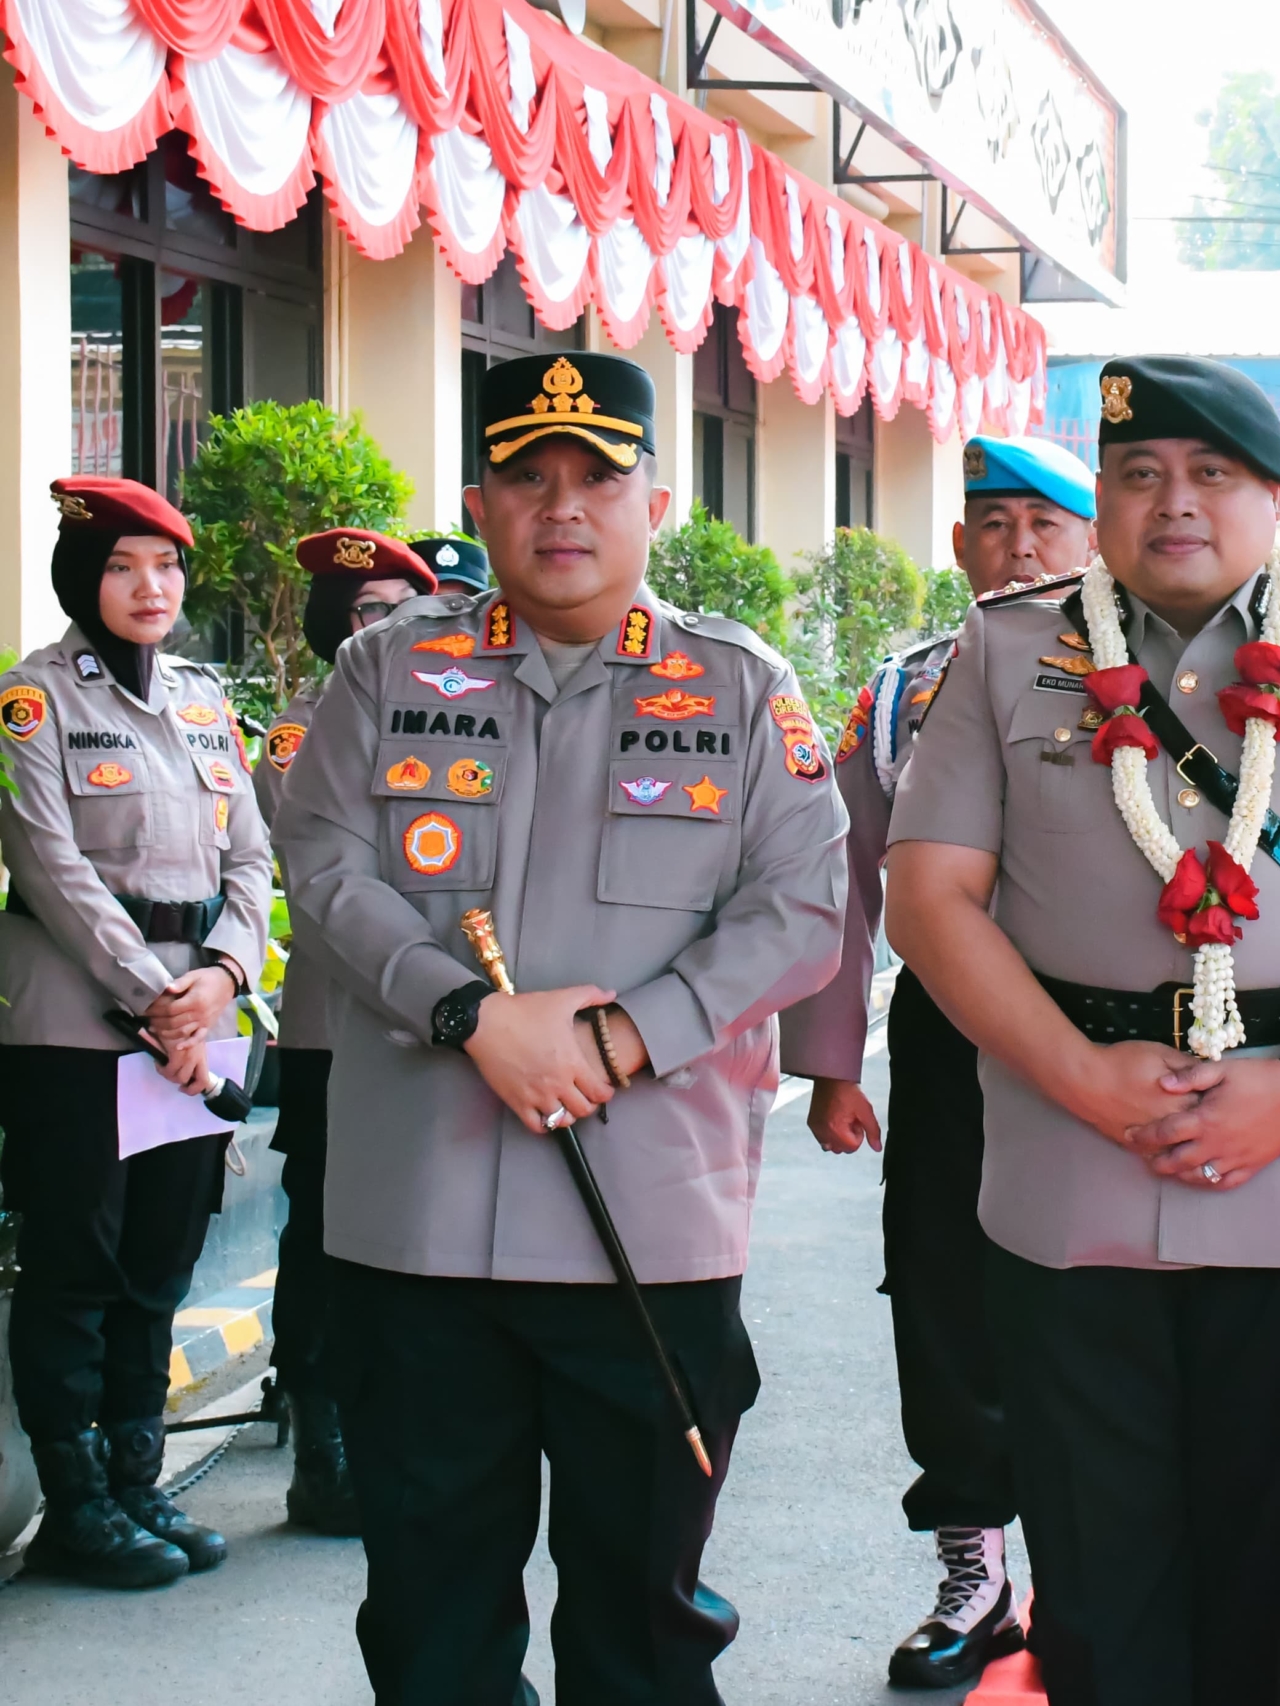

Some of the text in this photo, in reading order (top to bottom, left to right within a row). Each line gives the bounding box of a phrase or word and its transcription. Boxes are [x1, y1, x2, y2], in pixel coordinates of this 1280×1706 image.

[1041, 677, 1057, 686] EKO
[391, 709, 500, 739] IMARA
[68, 732, 137, 750] NINGKA
[186, 733, 229, 752] POLRI
[620, 729, 730, 755] POLRI
